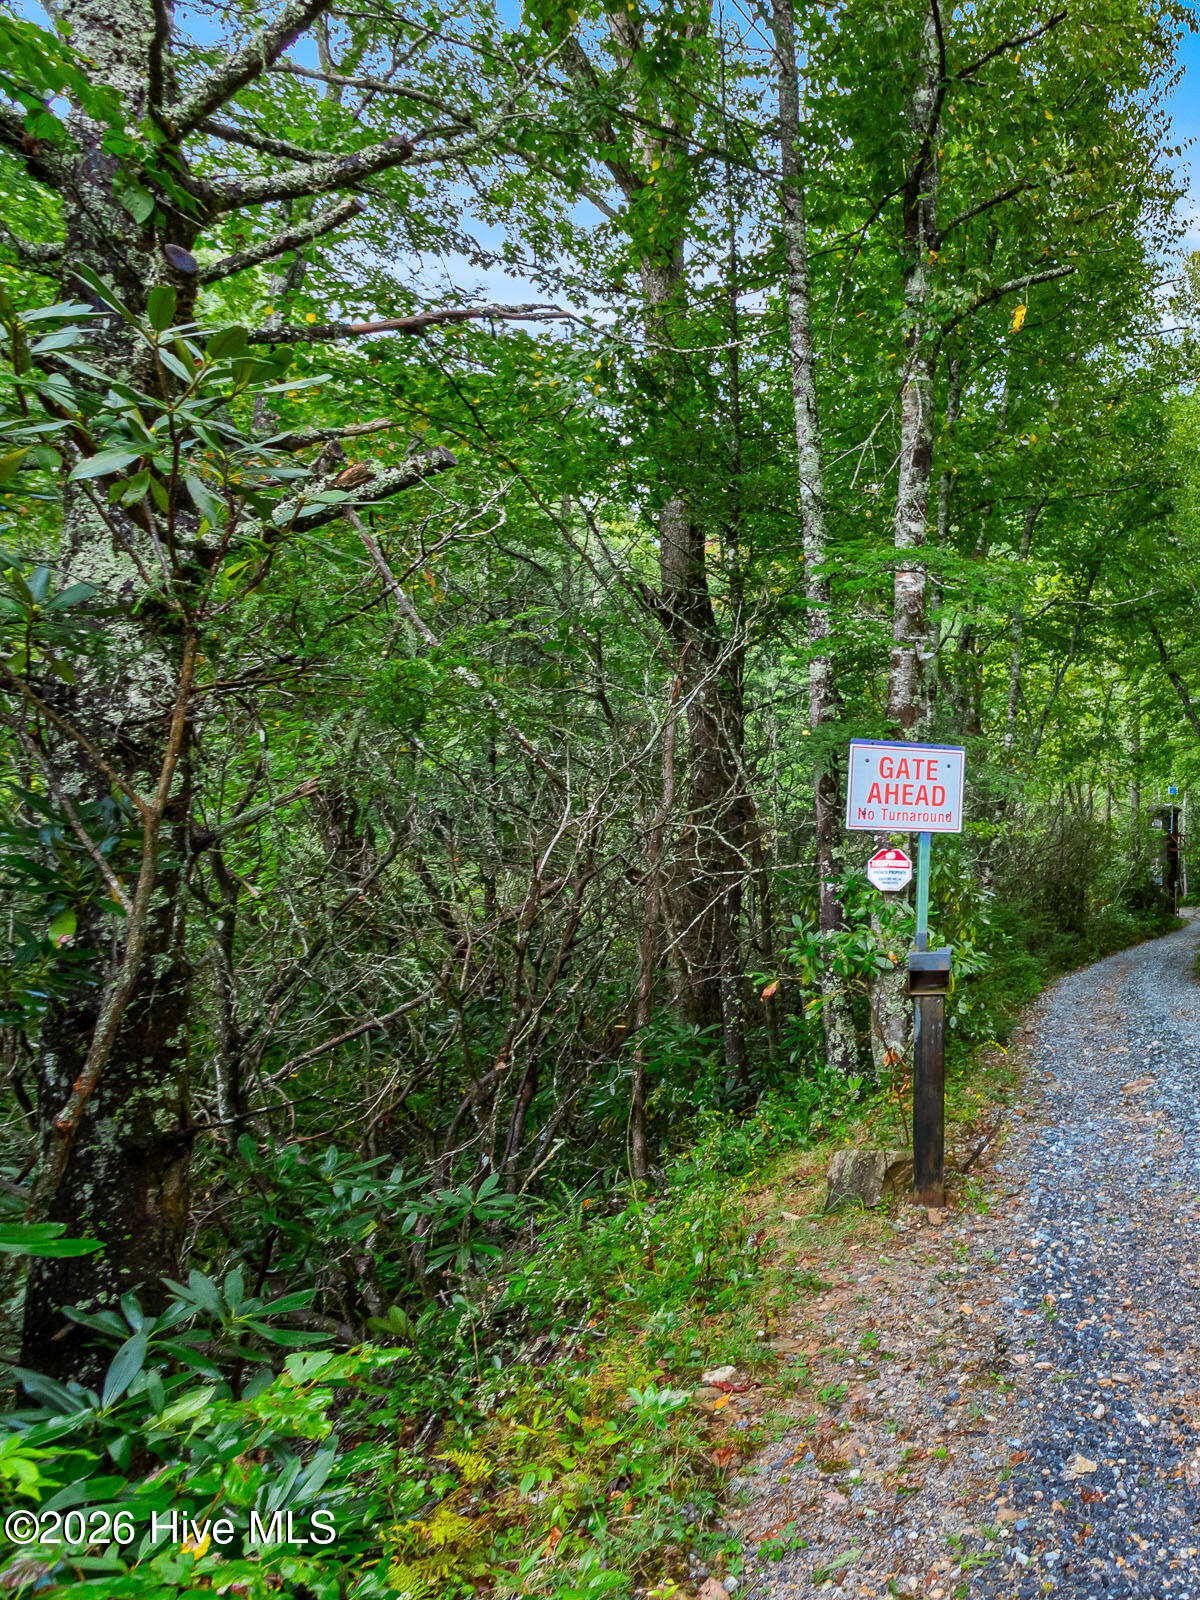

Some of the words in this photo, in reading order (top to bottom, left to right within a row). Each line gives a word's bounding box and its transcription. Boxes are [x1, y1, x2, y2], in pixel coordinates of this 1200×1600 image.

[879, 756, 939, 781] GATE
[866, 782, 946, 807] AHEAD
[857, 807, 875, 821] No
[881, 808, 953, 823] Turnaround
